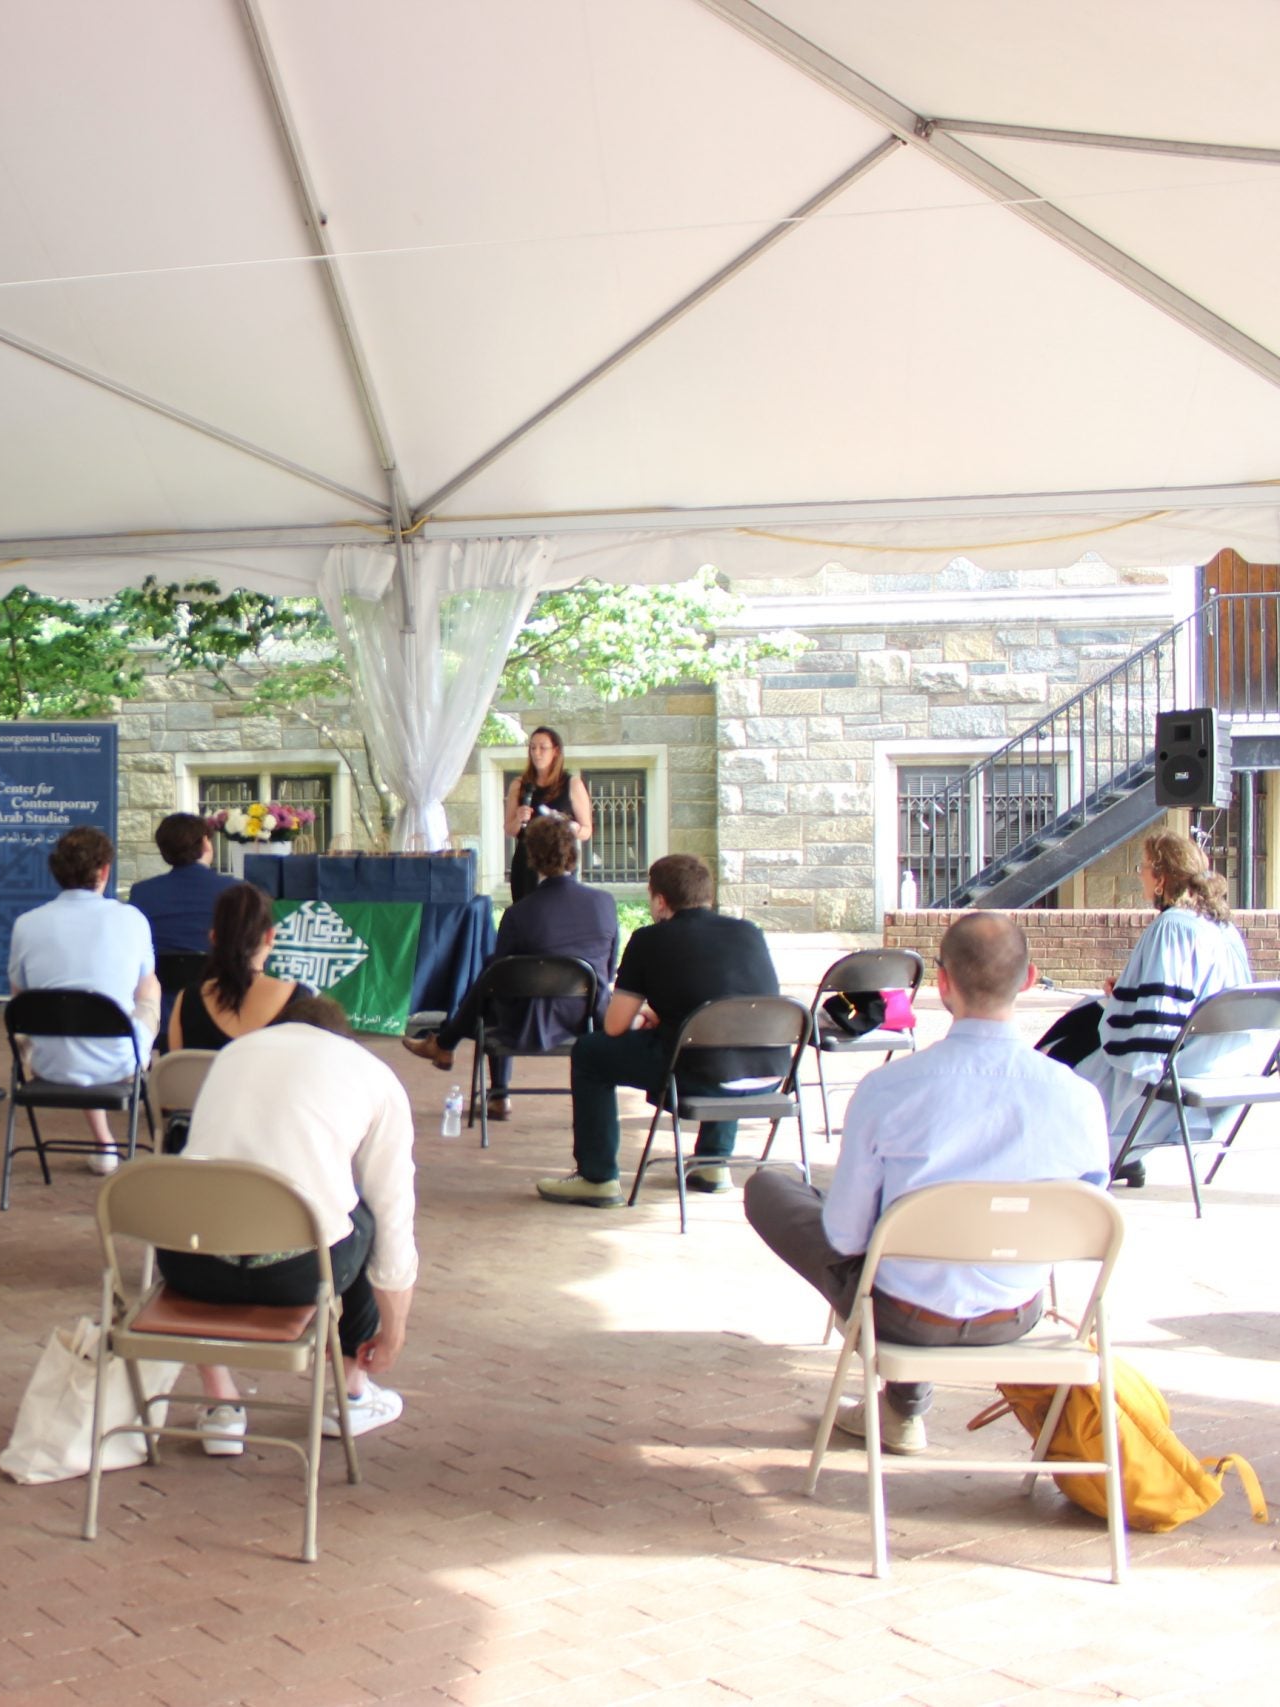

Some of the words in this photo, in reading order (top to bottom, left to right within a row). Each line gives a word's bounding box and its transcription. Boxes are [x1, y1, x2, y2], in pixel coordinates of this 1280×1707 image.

[50, 732, 101, 746] University
[34, 782, 54, 798] for
[10, 796, 99, 813] Contemporary
[25, 811, 70, 824] Studies
